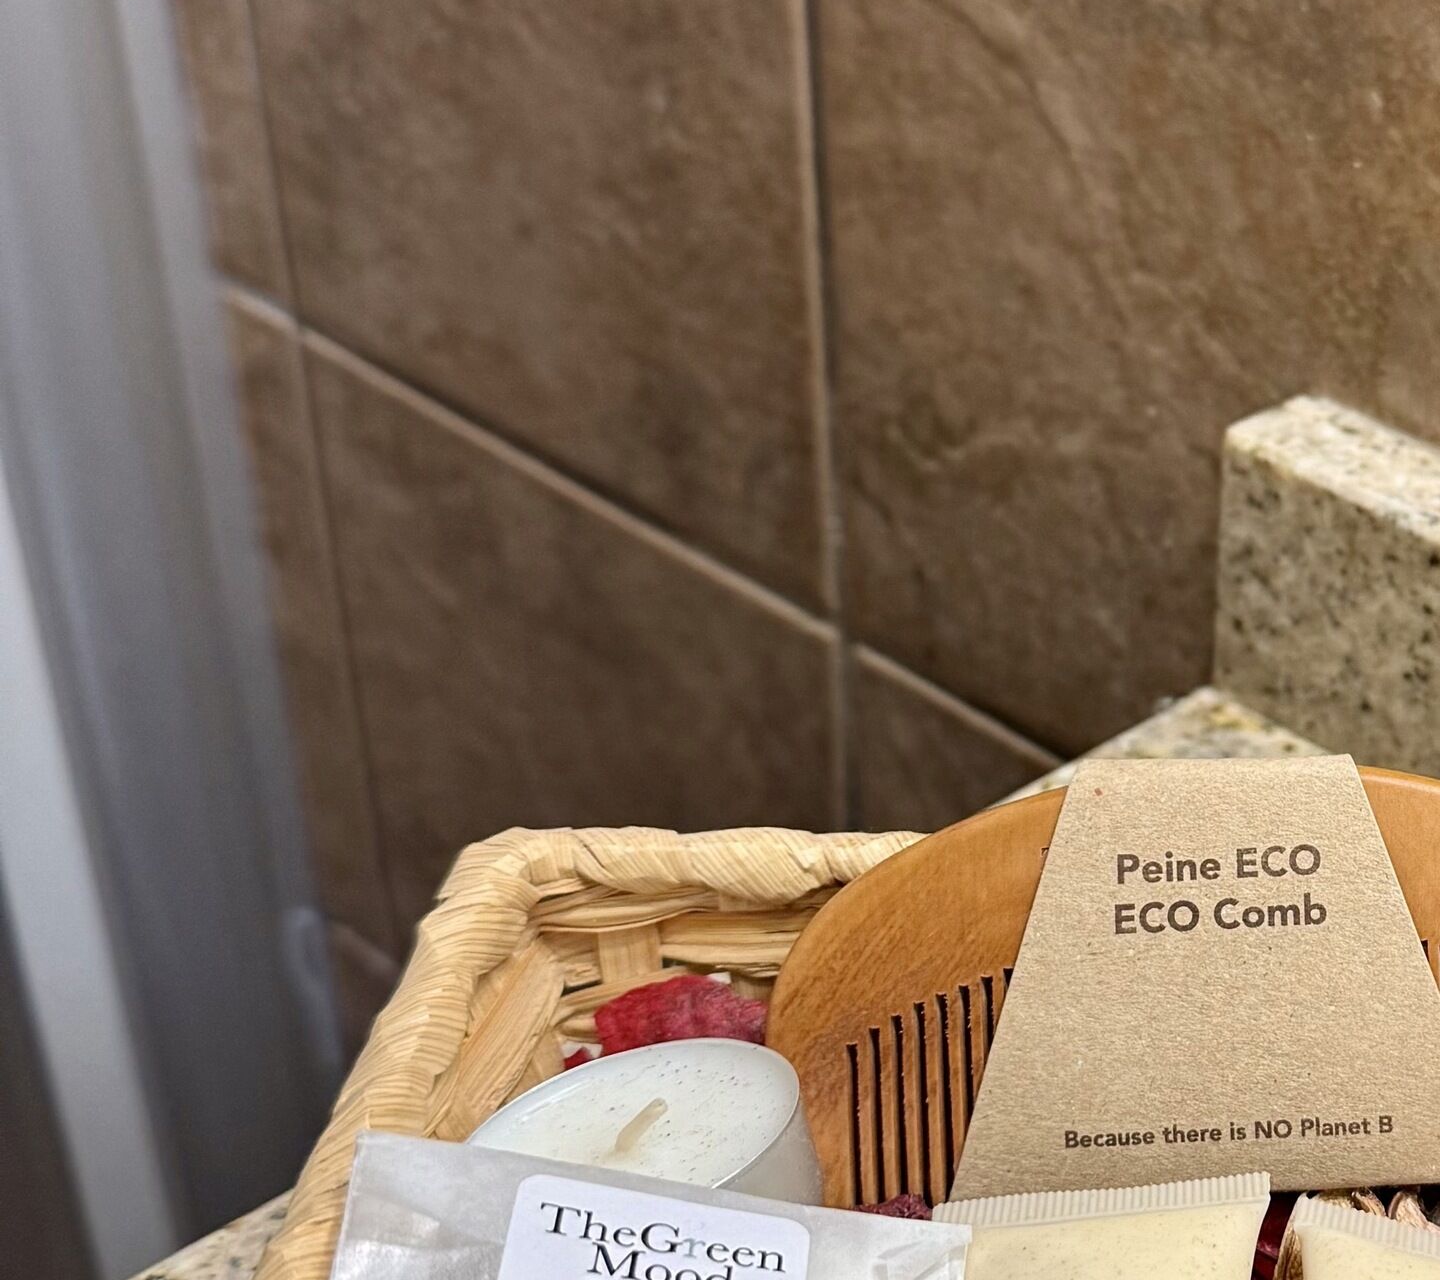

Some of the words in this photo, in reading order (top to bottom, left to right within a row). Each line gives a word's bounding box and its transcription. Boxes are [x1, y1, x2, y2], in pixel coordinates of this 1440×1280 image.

[1116, 852, 1220, 884] Peine
[1236, 844, 1322, 879] ECO
[1114, 900, 1200, 934] ECO
[1213, 893, 1327, 929] Comb
[1064, 1129, 1155, 1148] Because
[1162, 1124, 1222, 1144] there
[1229, 1122, 1246, 1140] is
[1254, 1119, 1292, 1140] NO
[1300, 1116, 1371, 1138] Planet
[1378, 1116, 1393, 1134] B
